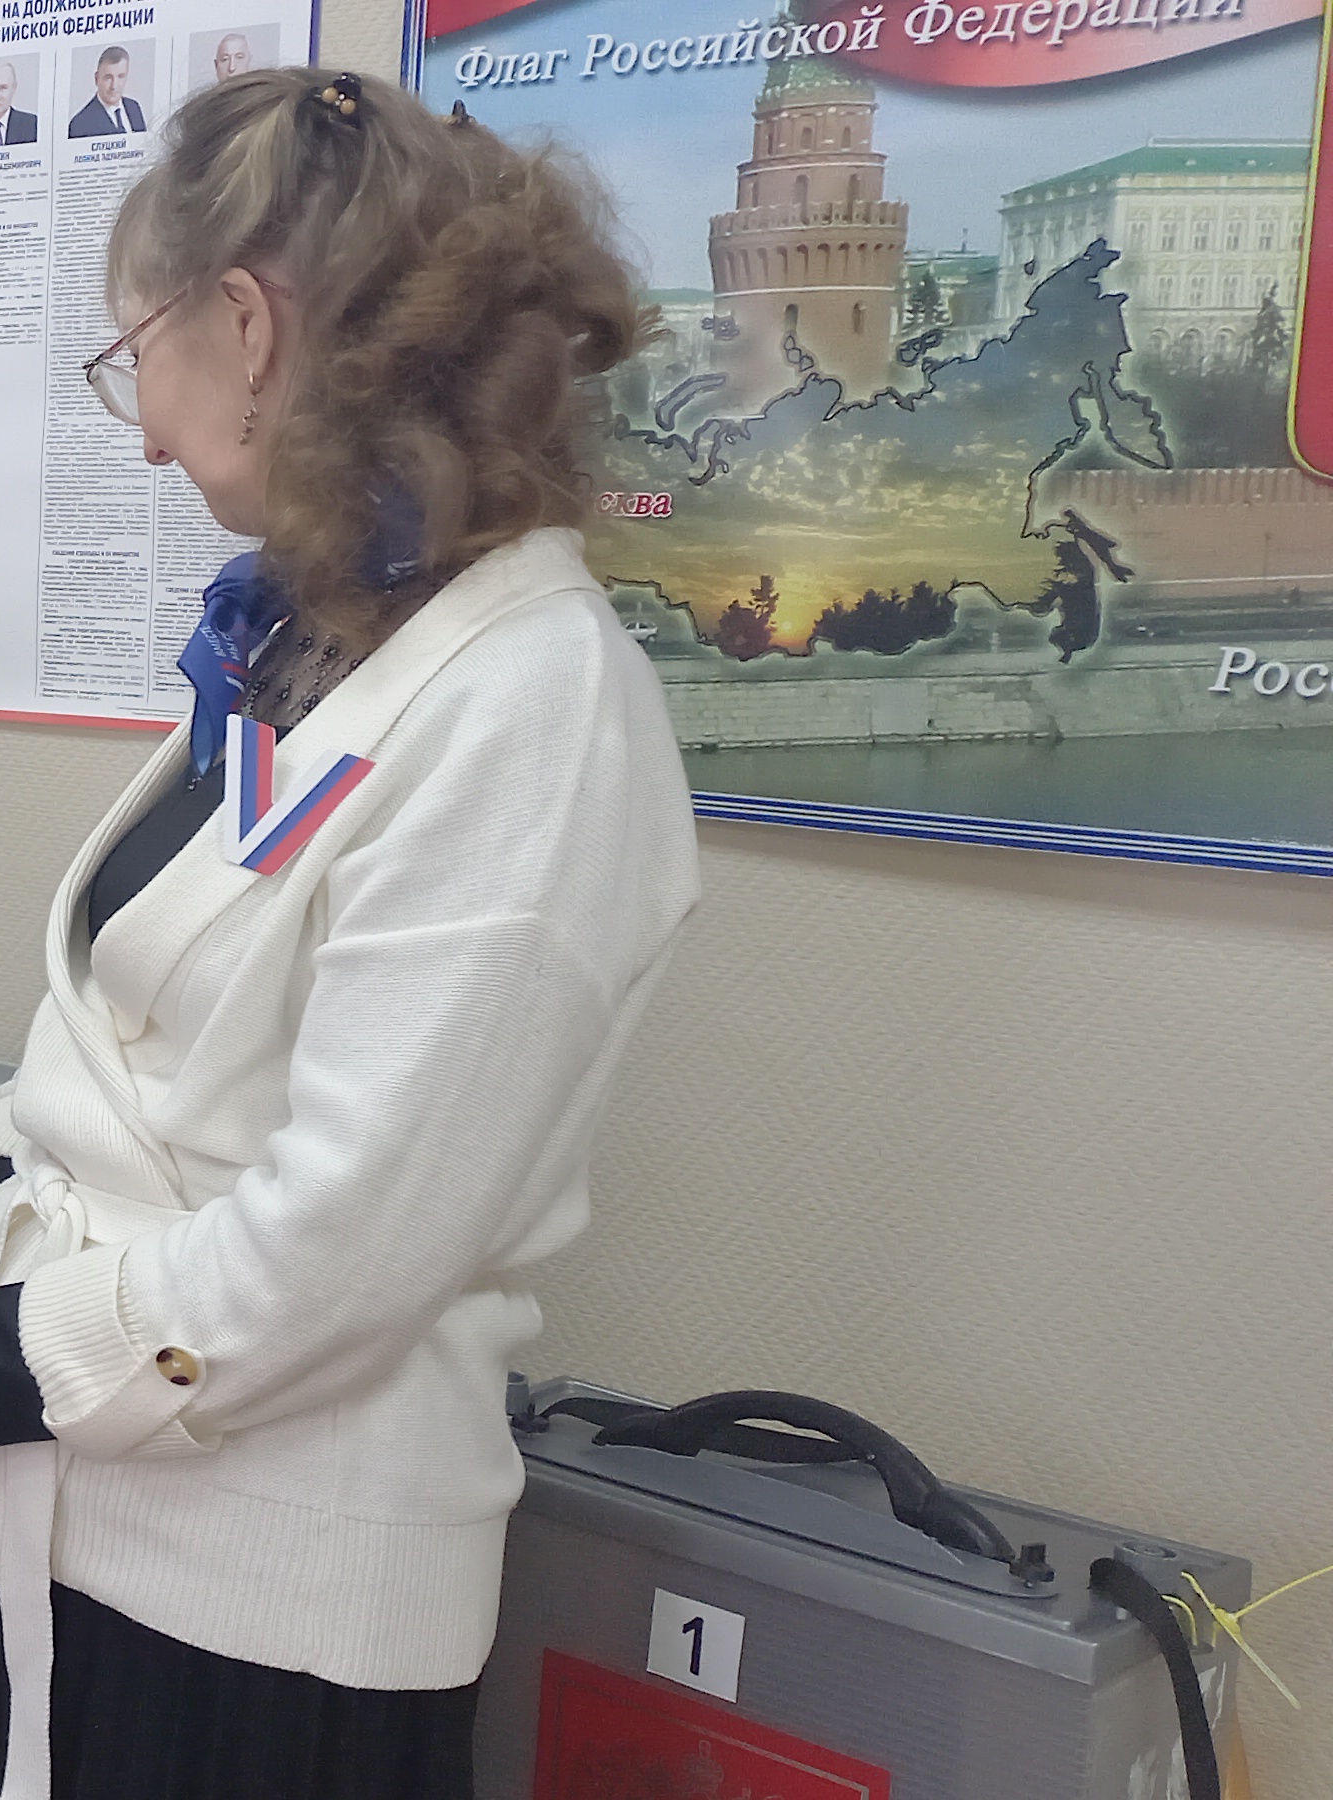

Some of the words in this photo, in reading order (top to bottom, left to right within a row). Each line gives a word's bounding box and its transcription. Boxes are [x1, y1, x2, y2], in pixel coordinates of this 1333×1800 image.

[2, 2, 20, 19] НА
[63, 7, 154, 36] ФЕДЕРАЦИИ
[454, 45, 568, 88] Флаг
[579, 3, 886, 77] Российской
[596, 491, 673, 517] сква
[1207, 646, 1333, 697] Рос
[681, 1616, 705, 1677] 1
